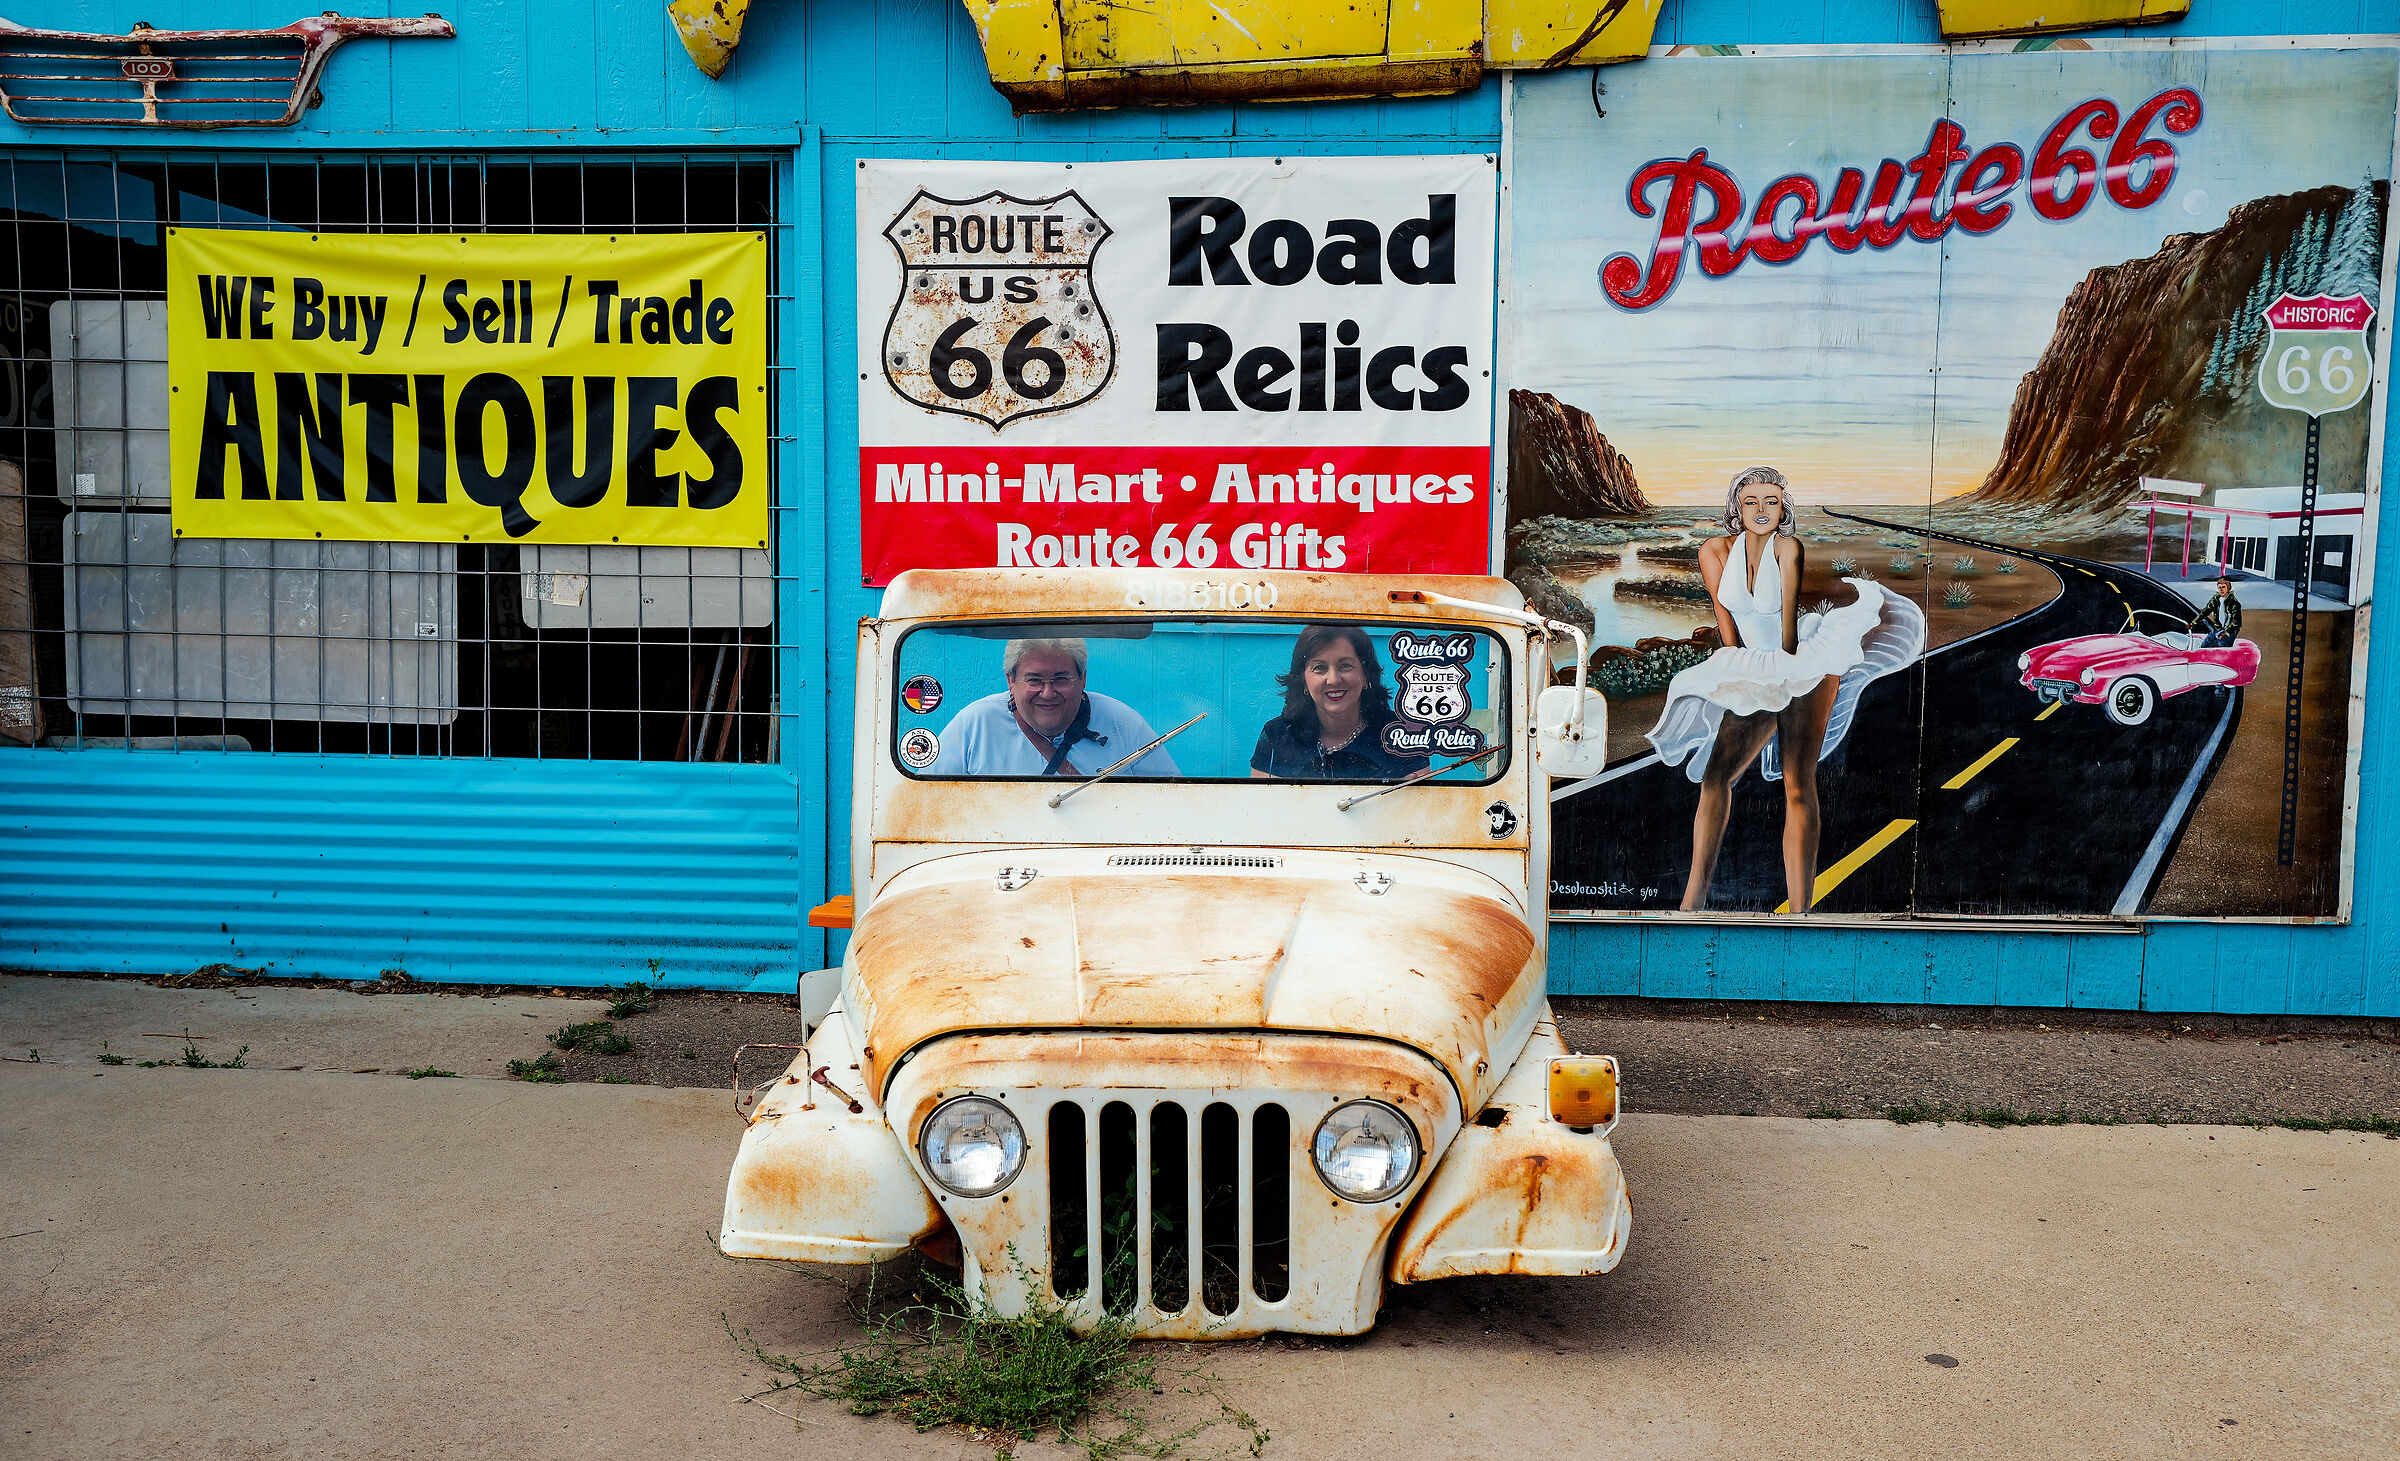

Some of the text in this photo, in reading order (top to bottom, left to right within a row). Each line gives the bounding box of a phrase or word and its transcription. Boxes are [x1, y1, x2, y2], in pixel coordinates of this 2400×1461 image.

[132, 63, 161, 73] 100
[932, 213, 1064, 254] ROUTE
[1168, 193, 1457, 287] Road
[959, 276, 1039, 304] US
[198, 274, 275, 341] WE
[292, 278, 386, 355] Buy
[443, 278, 533, 345] Sell
[587, 279, 735, 345] Trade
[2284, 306, 2356, 323] HISTORIC
[928, 316, 1066, 400] 66
[1155, 319, 1471, 412] Relics
[2277, 345, 2354, 395] 66
[195, 370, 744, 538] ANTIQUES
[875, 462, 1475, 512] Mini-Mart Antiques
[996, 522, 1346, 569] Route 66 Gifts
[1395, 636, 1468, 661] Route 66
[1412, 673, 1454, 682] ROUTE
[1423, 685, 1445, 693] US
[1416, 695, 1452, 716] 66
[1390, 728, 1478, 750] Road Relics
[1639, 886, 1658, 901] 5/09
